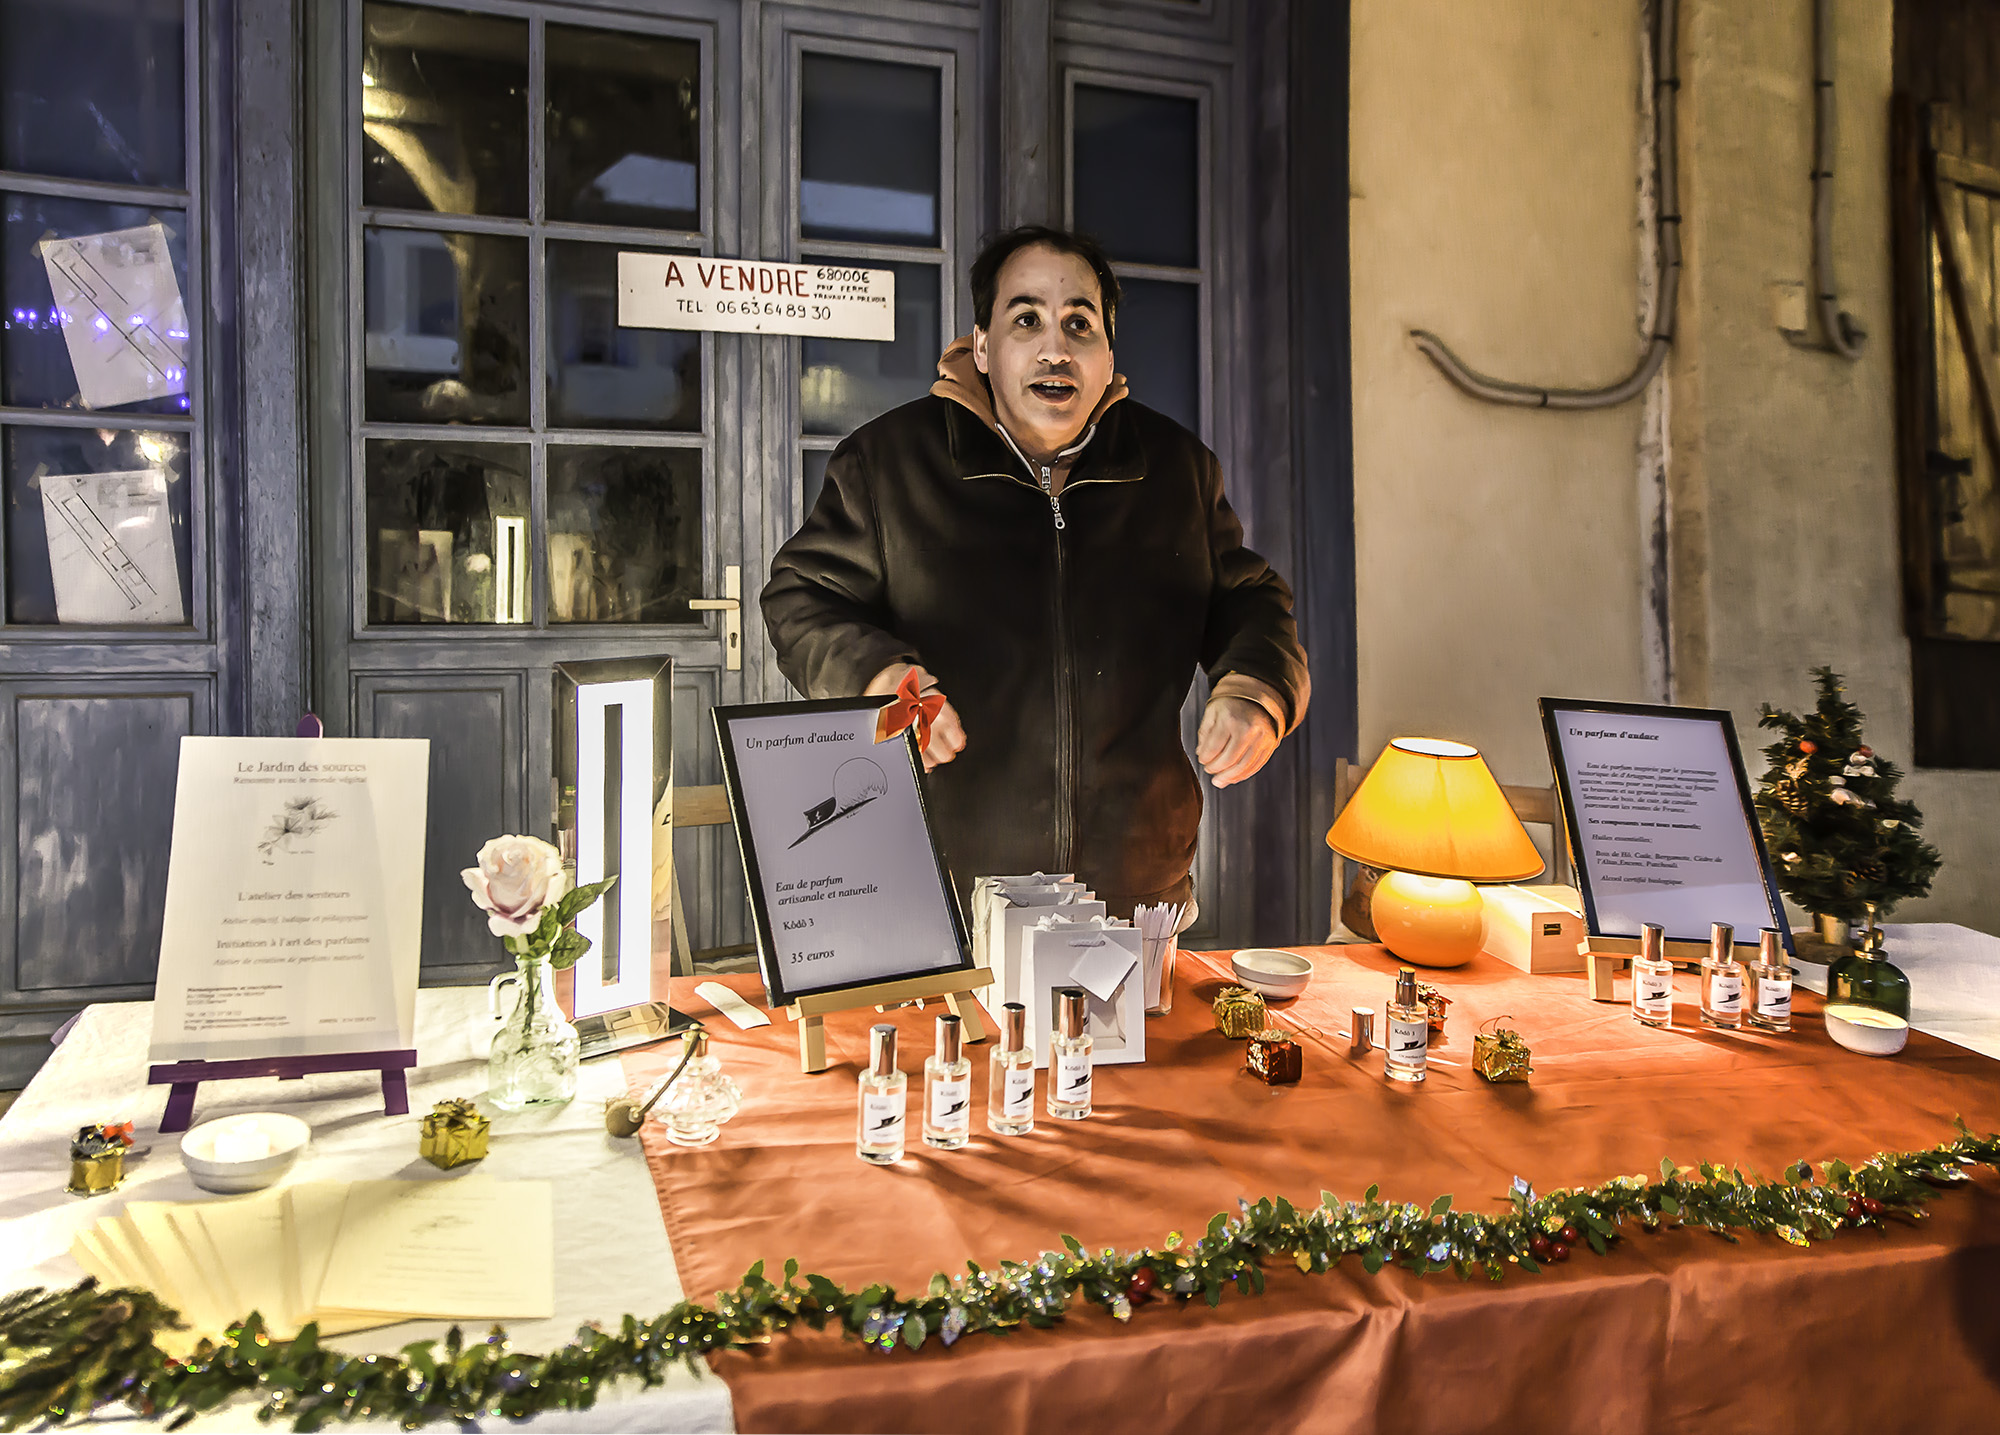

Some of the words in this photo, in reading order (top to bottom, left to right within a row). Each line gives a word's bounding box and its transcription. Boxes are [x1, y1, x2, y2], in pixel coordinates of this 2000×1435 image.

[665, 261, 685, 288] A
[698, 263, 809, 297] VENDRE
[817, 268, 870, 284] 68000€
[676, 299, 703, 313] TEL
[746, 738, 762, 748] Un
[766, 734, 804, 750] parfum
[807, 731, 854, 744] d'audace
[1585, 730, 1617, 739] parfum
[1620, 731, 1660, 740] d'audace
[238, 762, 254, 772] Le
[257, 762, 294, 772] Jardin
[298, 762, 318, 772] des
[322, 764, 366, 772] sources
[776, 882, 794, 892] Eau
[797, 880, 808, 889] de
[810, 876, 843, 890] parfum
[778, 891, 825, 906] artisanale
[827, 890, 836, 899] et
[838, 884, 878, 897] naturelle
[809, 918, 814, 927] 3
[791, 952, 803, 964] 35
[807, 950, 835, 961] euros
